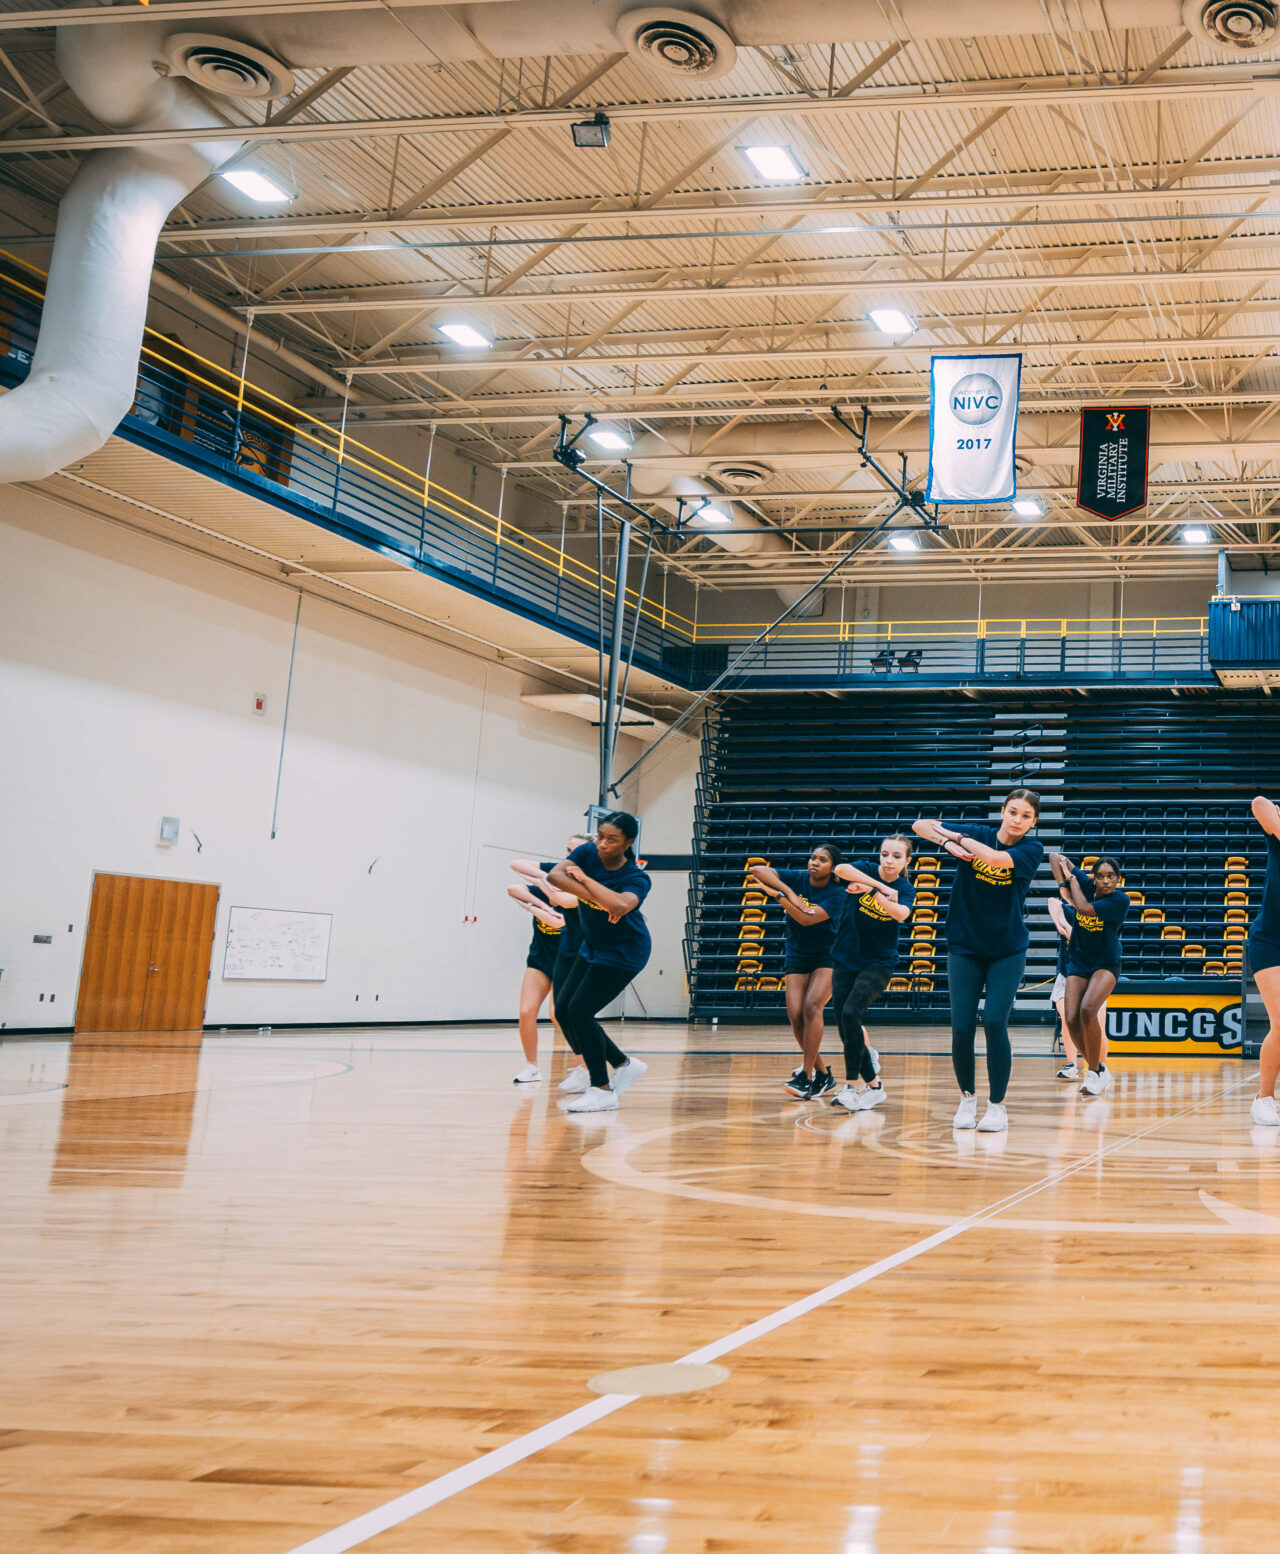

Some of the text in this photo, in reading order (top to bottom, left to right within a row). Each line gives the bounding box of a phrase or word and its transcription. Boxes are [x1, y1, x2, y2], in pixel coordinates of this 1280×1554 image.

[953, 395, 999, 410] NIVC
[956, 438, 992, 450] 2017
[1097, 443, 1108, 498] VIRGINIA
[1107, 442, 1118, 499] MILITARY
[1117, 438, 1128, 503] INSTITUTE
[975, 873, 997, 886] DANCE
